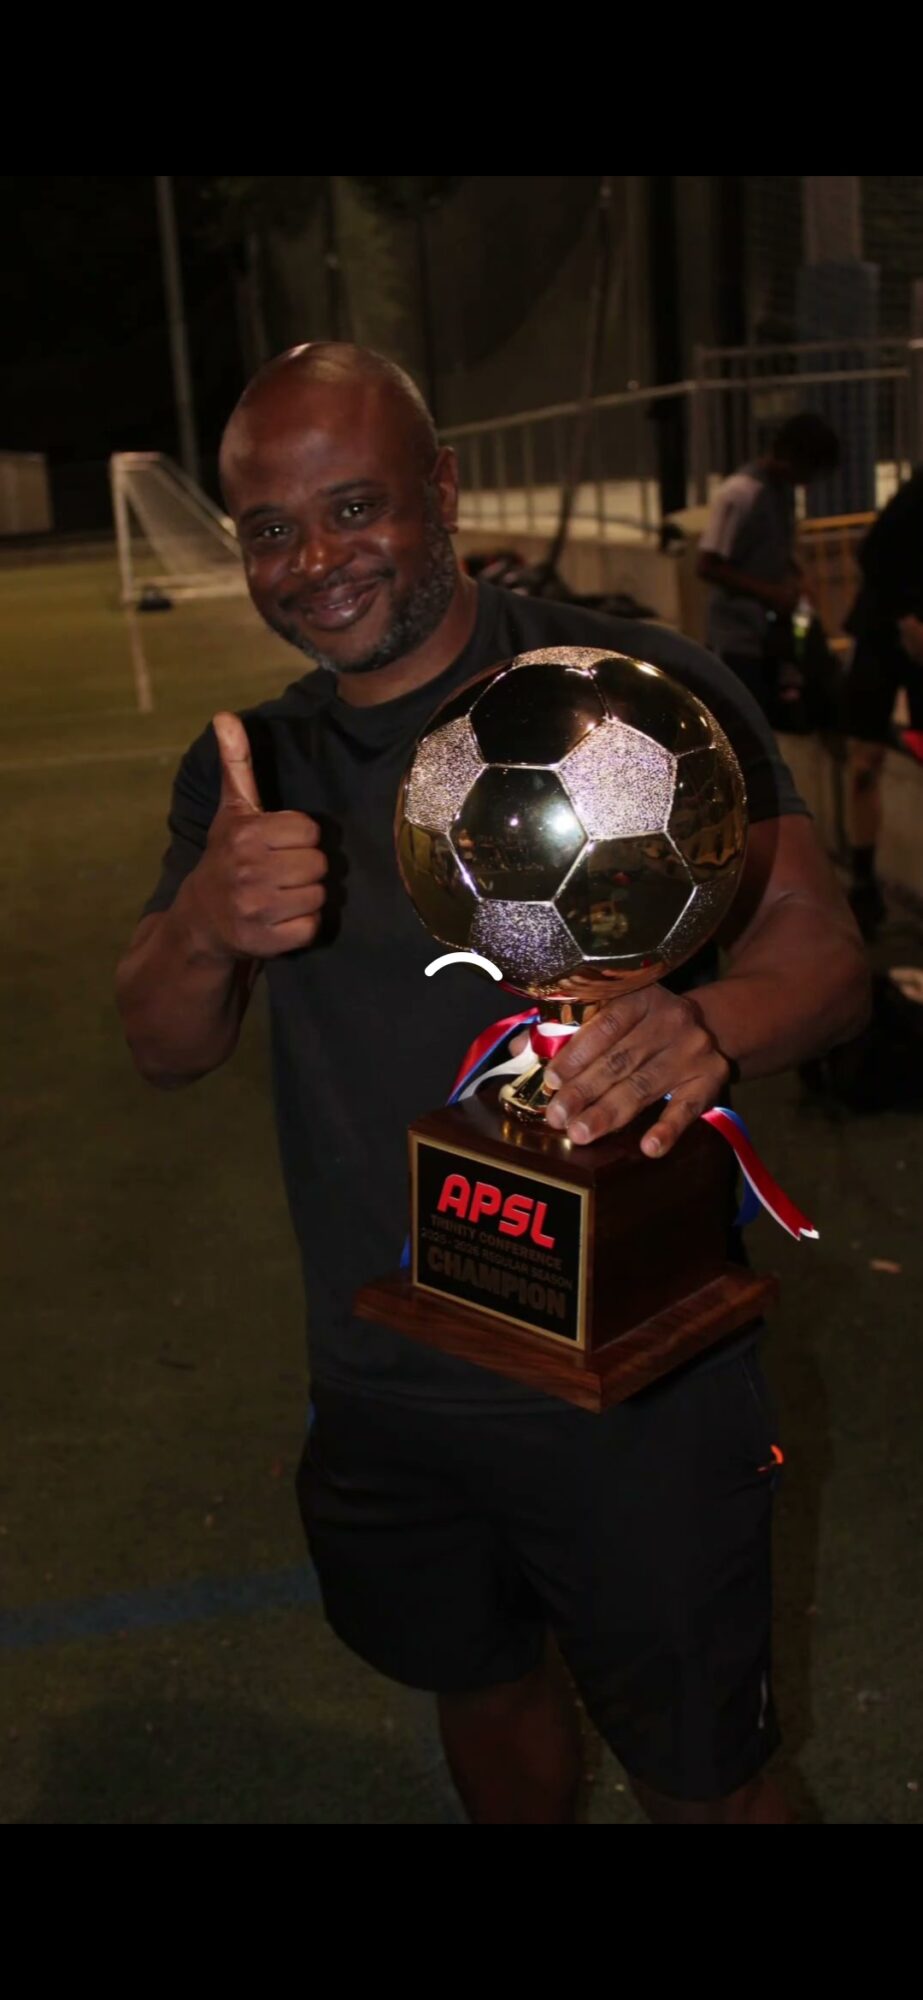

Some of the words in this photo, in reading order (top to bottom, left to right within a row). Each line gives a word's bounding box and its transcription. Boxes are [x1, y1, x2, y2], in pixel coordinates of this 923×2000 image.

[431, 1214, 477, 1239] TRINITY
[479, 1231, 563, 1270] CONFERENCE
[437, 1173, 556, 1250] APSL
[427, 1245, 566, 1319] CHAMPION
[481, 1248, 529, 1273] REGULAR
[531, 1267, 573, 1290] SEASON
